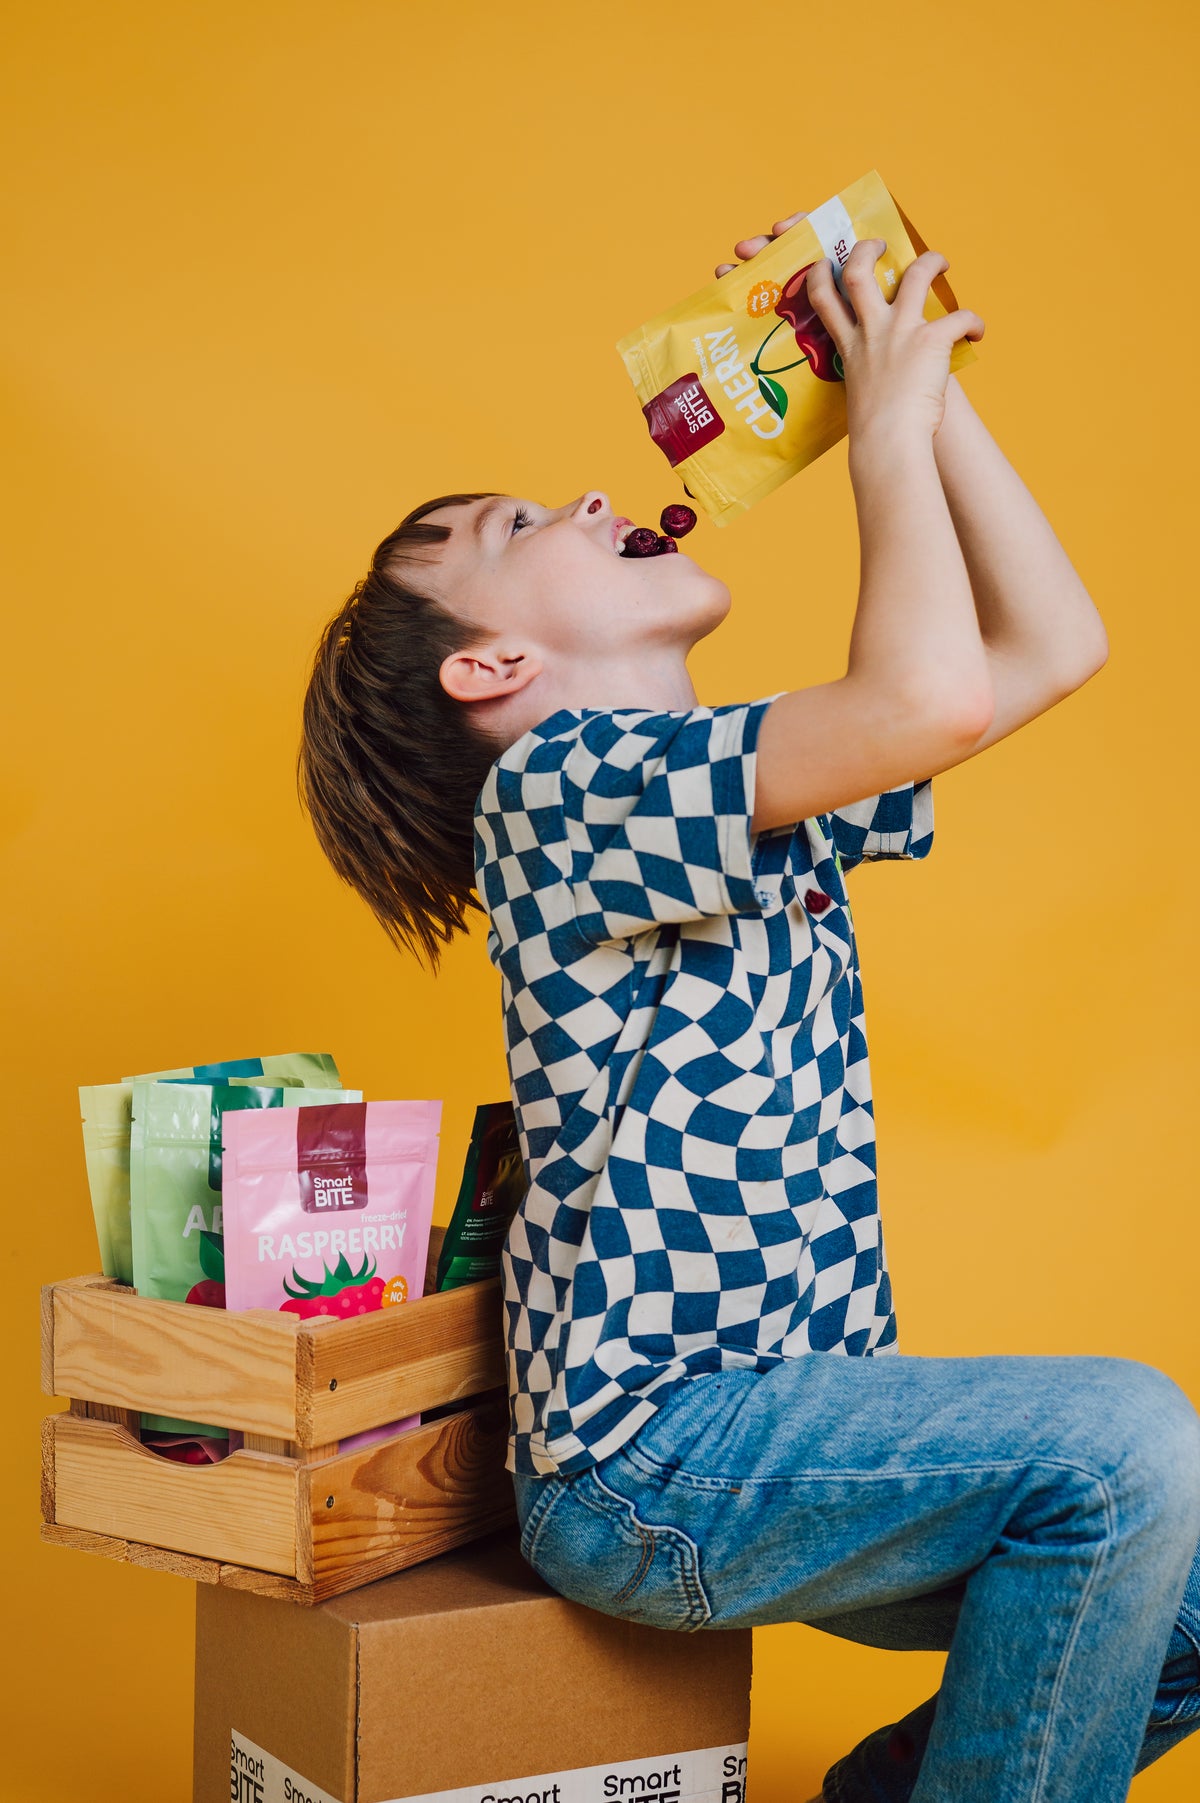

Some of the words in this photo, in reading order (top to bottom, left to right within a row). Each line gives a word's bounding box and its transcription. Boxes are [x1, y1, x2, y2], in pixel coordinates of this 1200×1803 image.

[704, 326, 785, 439] CHERRY
[682, 384, 715, 429] BITE
[313, 1175, 353, 1189] Smart
[314, 1187, 354, 1208] BITE
[258, 1222, 407, 1263] RASPBERRY
[390, 1291, 403, 1303] NO
[603, 1764, 682, 1797] Smart
